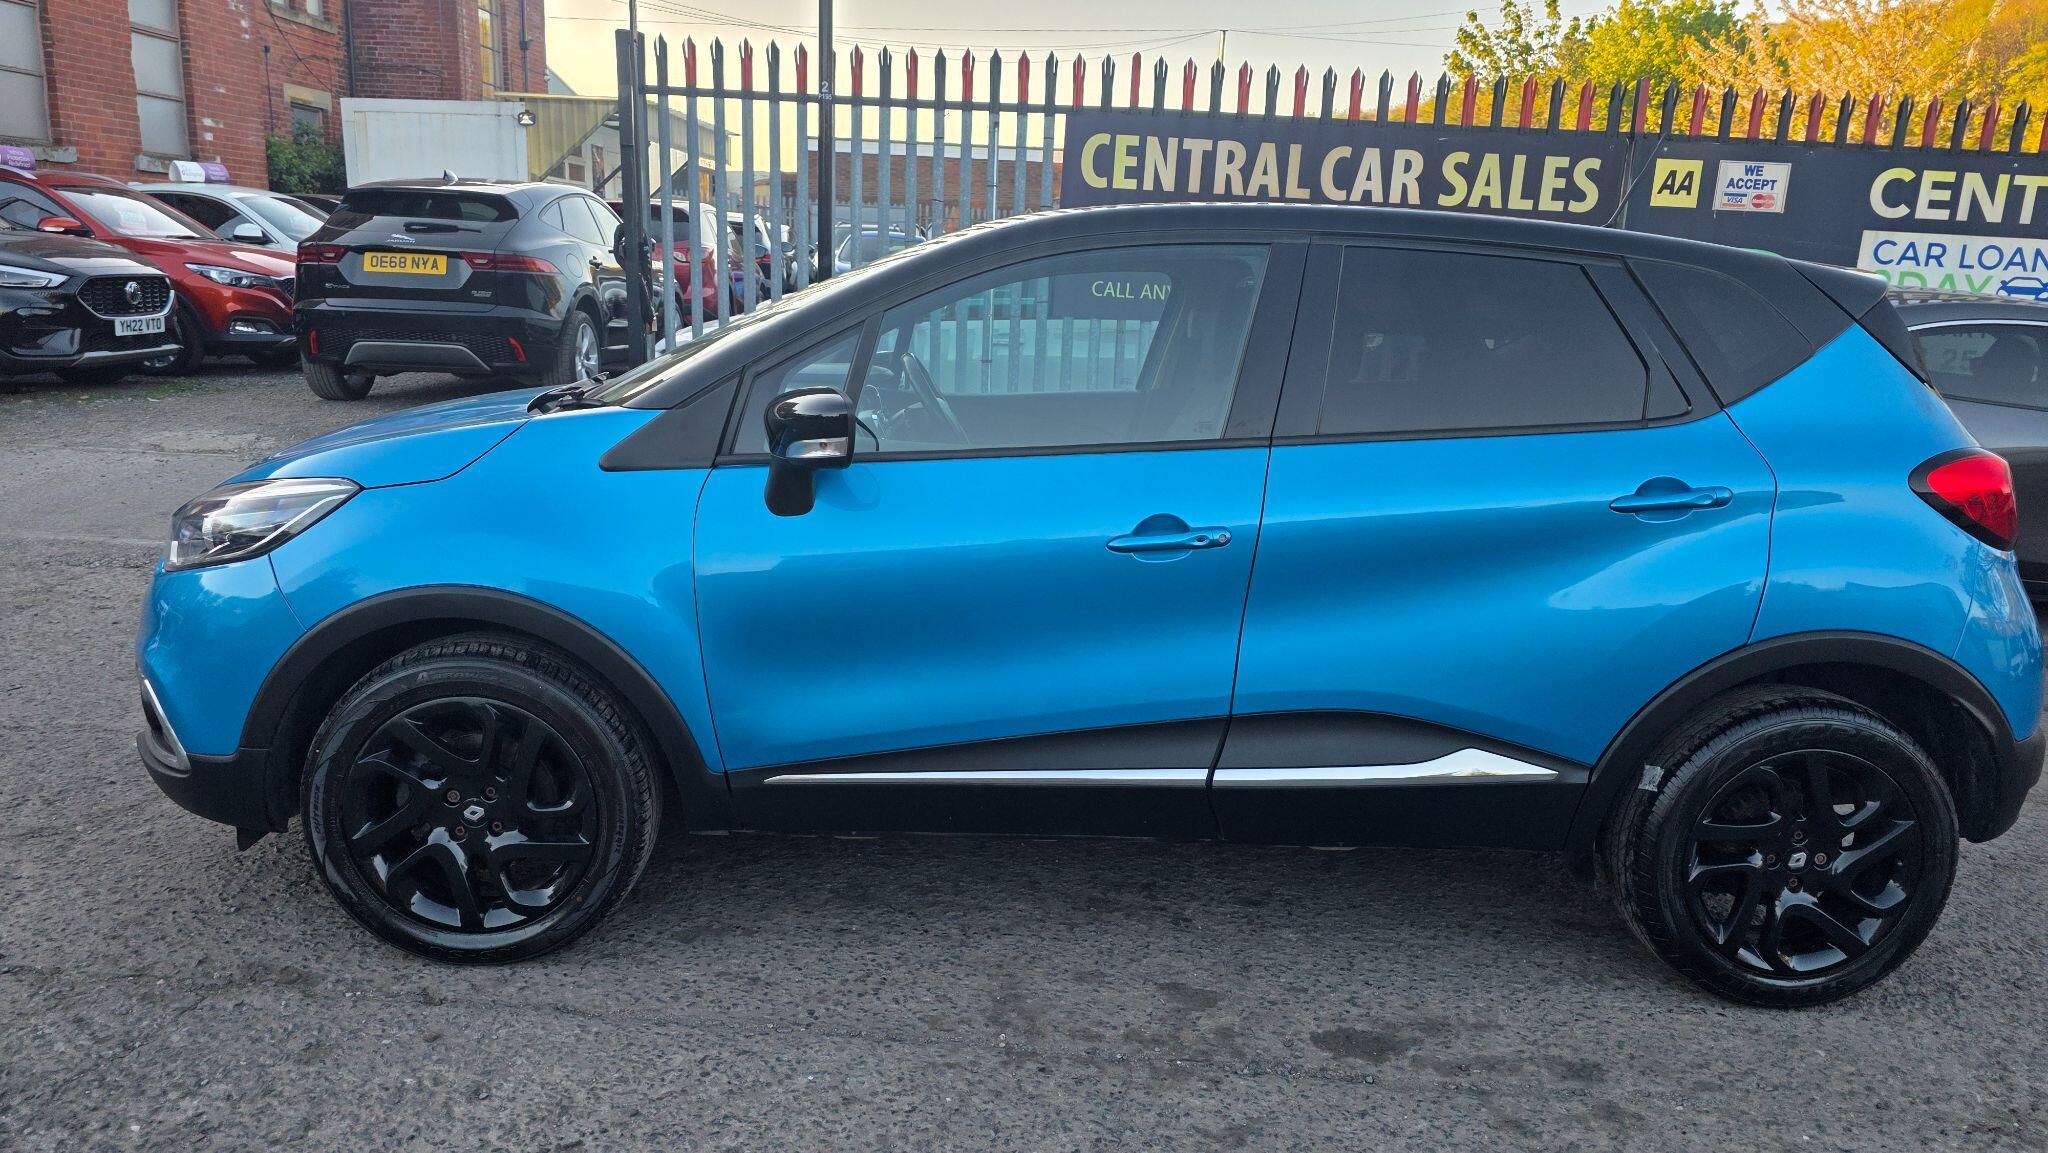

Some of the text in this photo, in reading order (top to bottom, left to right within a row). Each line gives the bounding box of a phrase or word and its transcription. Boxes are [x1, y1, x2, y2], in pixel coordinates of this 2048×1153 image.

[821, 80, 829, 92] 2
[1080, 132, 1602, 214] CENTRAL CAR SALES
[1744, 164, 1765, 177] WE
[1656, 169, 1695, 196] AA
[1726, 177, 1778, 191] ACCEPT
[1726, 196, 1744, 204] VISA
[1869, 167, 2048, 225] CENT
[1873, 239, 1948, 268] CAR
[370, 255, 440, 271] OE68 NYA
[1091, 280, 1135, 299] CALL
[119, 317, 162, 333] YH22 VTO
